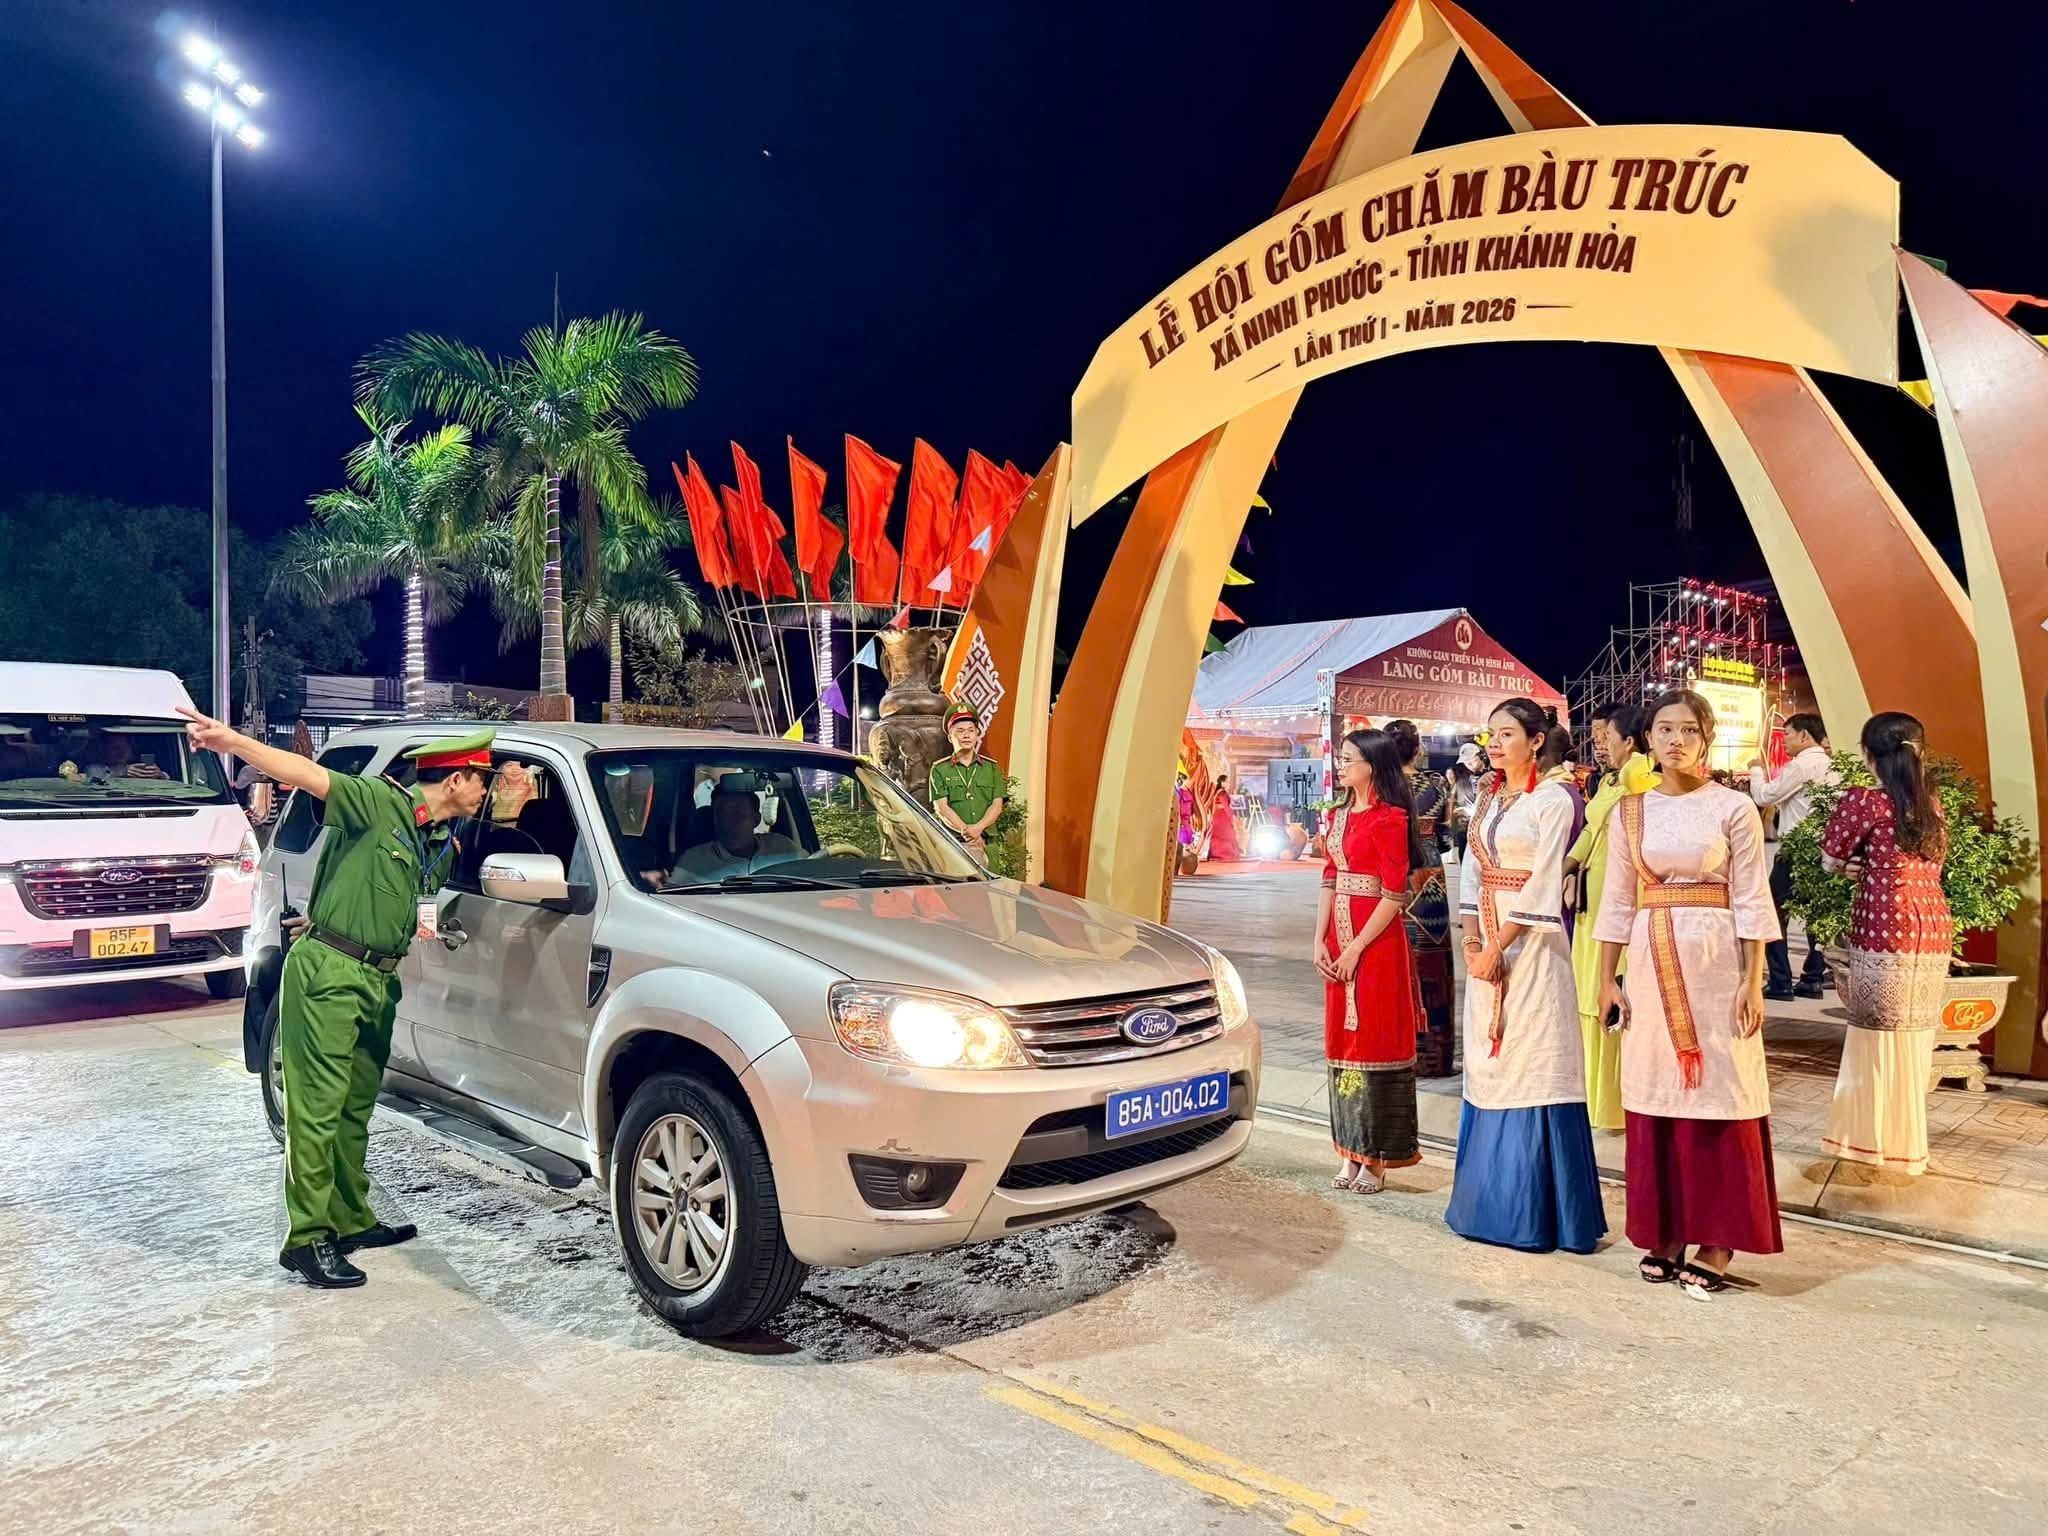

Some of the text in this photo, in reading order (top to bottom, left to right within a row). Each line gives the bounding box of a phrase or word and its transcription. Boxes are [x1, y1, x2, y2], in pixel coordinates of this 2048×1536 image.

[1139, 148, 1749, 369] LỄ HỘI GỐM CHĂM BÀU TRÚC
[1210, 325, 1241, 371] XÃ
[1241, 296, 1298, 350] NINH
[1303, 259, 1383, 318] PHƯỚC
[1407, 234, 1469, 281] TỈNH
[1474, 225, 1573, 272] KHÁNH
[1575, 222, 1637, 273] HÒA
[1294, 332, 1333, 368] LẦN
[1338, 315, 1377, 350] THỨ
[1380, 317, 1387, 339] I
[1405, 299, 1454, 332] NĂM
[1461, 297, 1516, 324] 2026
[1406, 647, 1432, 660] KHÔNG
[1433, 650, 1450, 661] GIAN
[1451, 652, 1471, 665] TRIỂN
[1383, 657, 1534, 693] LÀNG GỐM BÀU TRÚC
[97, 941, 148, 957] 002.47
[109, 928, 137, 941] 85F
[1140, 1014, 1169, 1035] Ford
[1118, 1079, 1220, 1127] 85A-004.02
